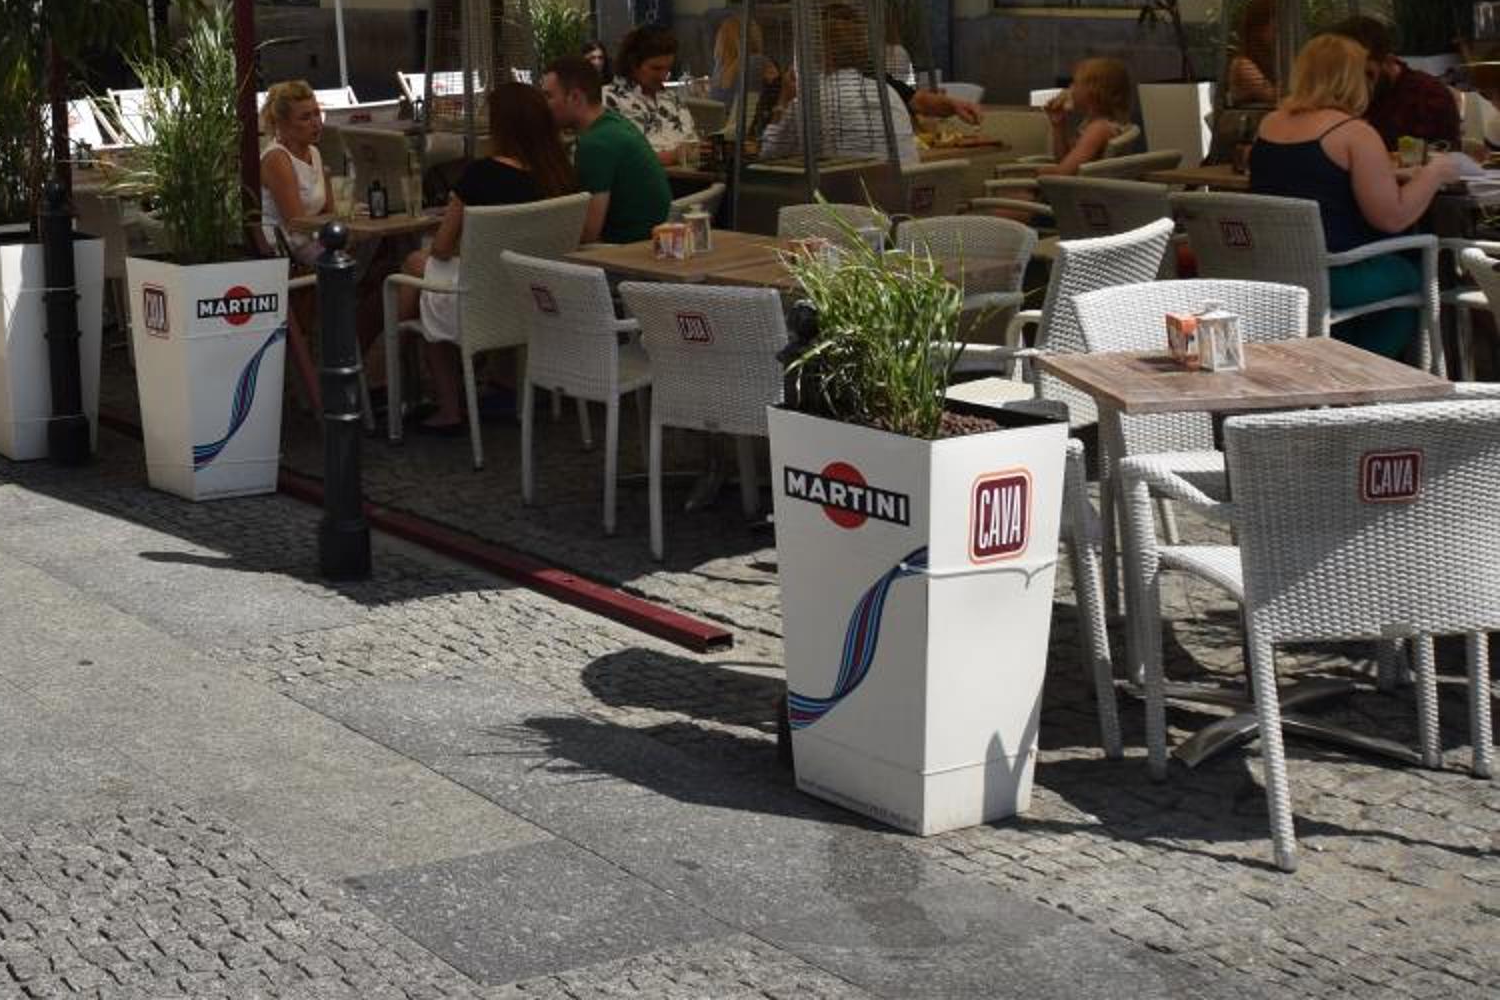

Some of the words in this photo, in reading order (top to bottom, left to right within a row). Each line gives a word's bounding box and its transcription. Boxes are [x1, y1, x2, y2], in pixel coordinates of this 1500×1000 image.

[200, 296, 276, 316] MARTINI
[787, 471, 906, 522] MARTINI
[1372, 459, 1412, 495] CAVA
[979, 486, 1021, 549] CAVA
